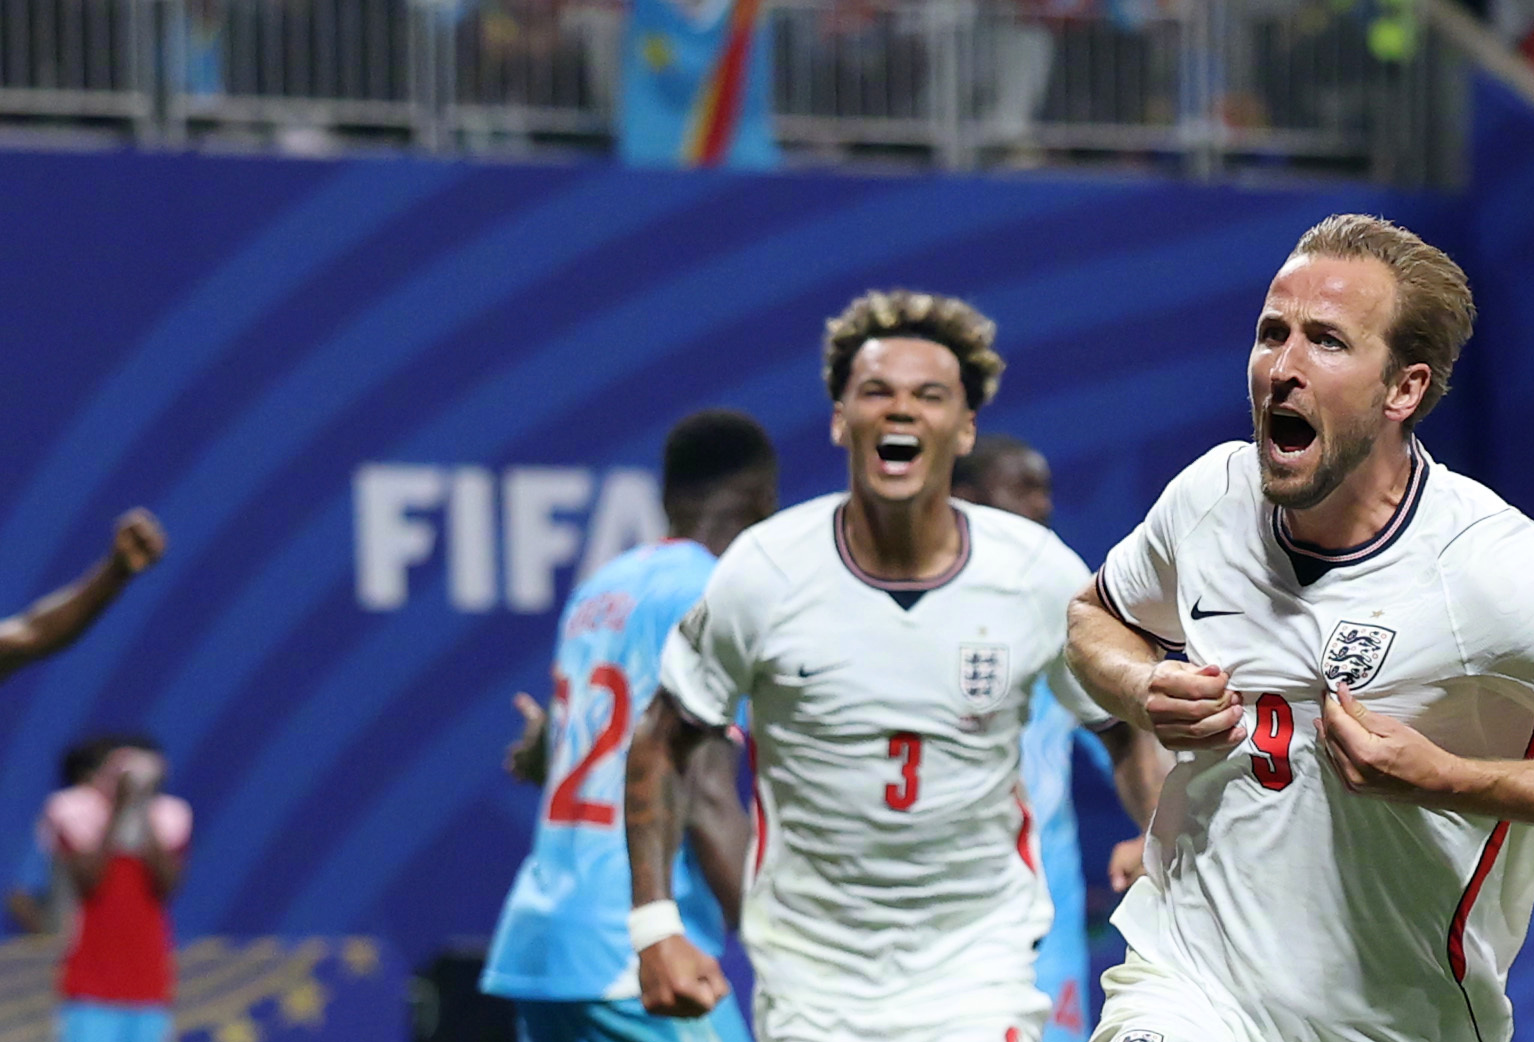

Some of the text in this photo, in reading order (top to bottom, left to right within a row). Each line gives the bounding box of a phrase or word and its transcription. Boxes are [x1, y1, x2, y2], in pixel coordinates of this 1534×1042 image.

[356, 464, 668, 612] FIFA
[885, 731, 921, 812] 3
[1250, 692, 1294, 792] 9
